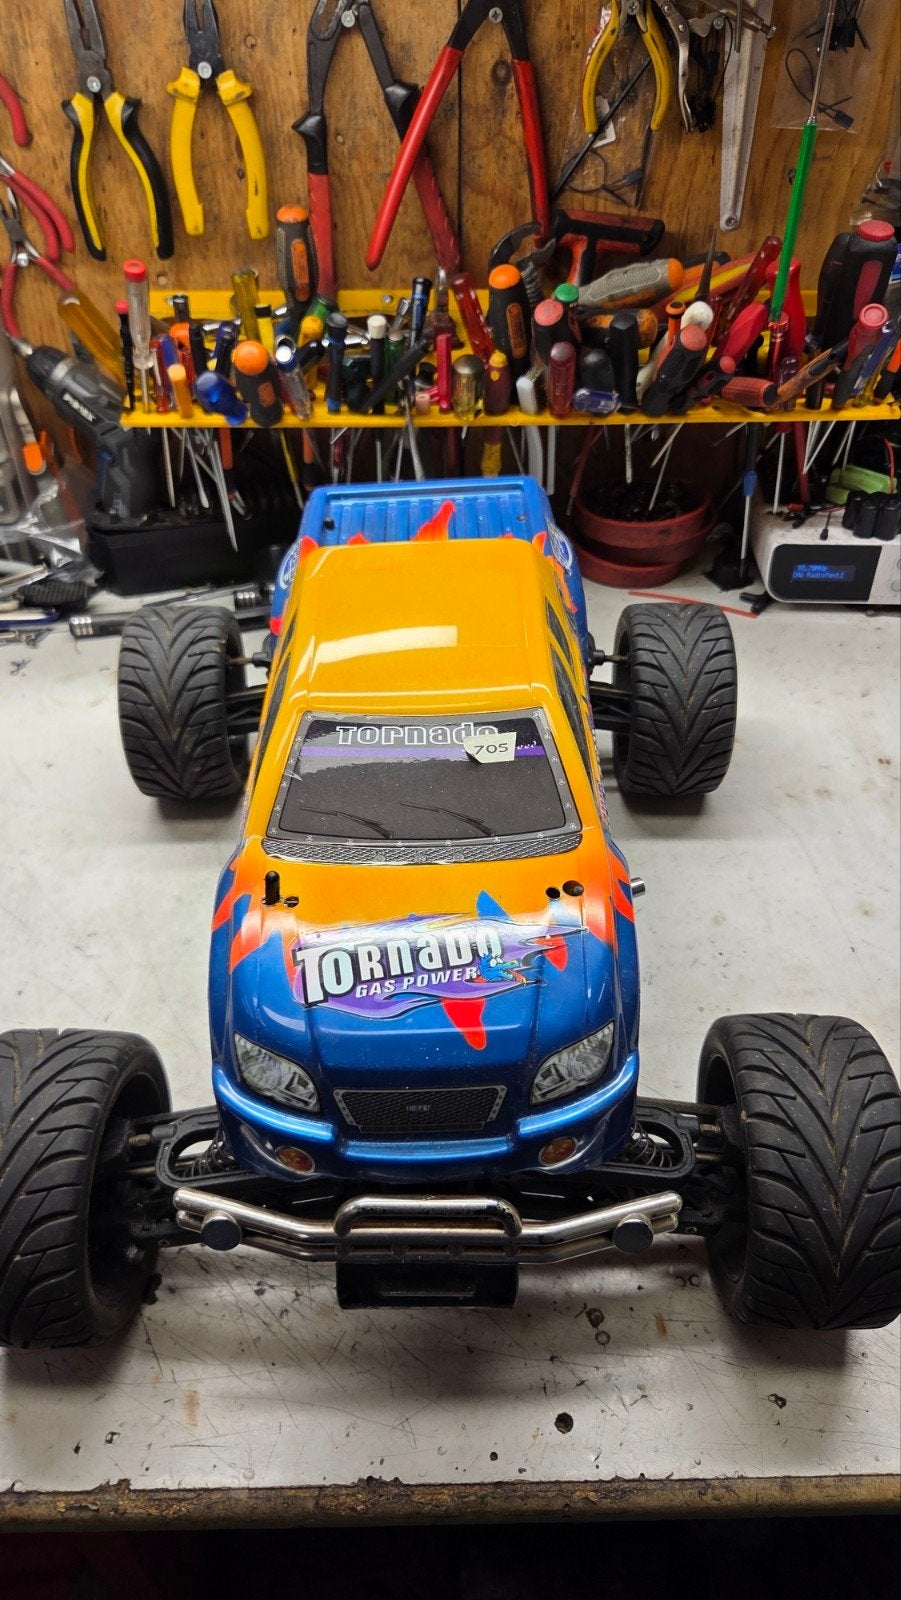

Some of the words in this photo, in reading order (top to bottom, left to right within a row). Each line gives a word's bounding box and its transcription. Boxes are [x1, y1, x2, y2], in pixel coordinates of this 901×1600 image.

[474, 742, 508, 755] 705
[355, 979, 396, 998] GAS
[402, 966, 480, 991] POWER
